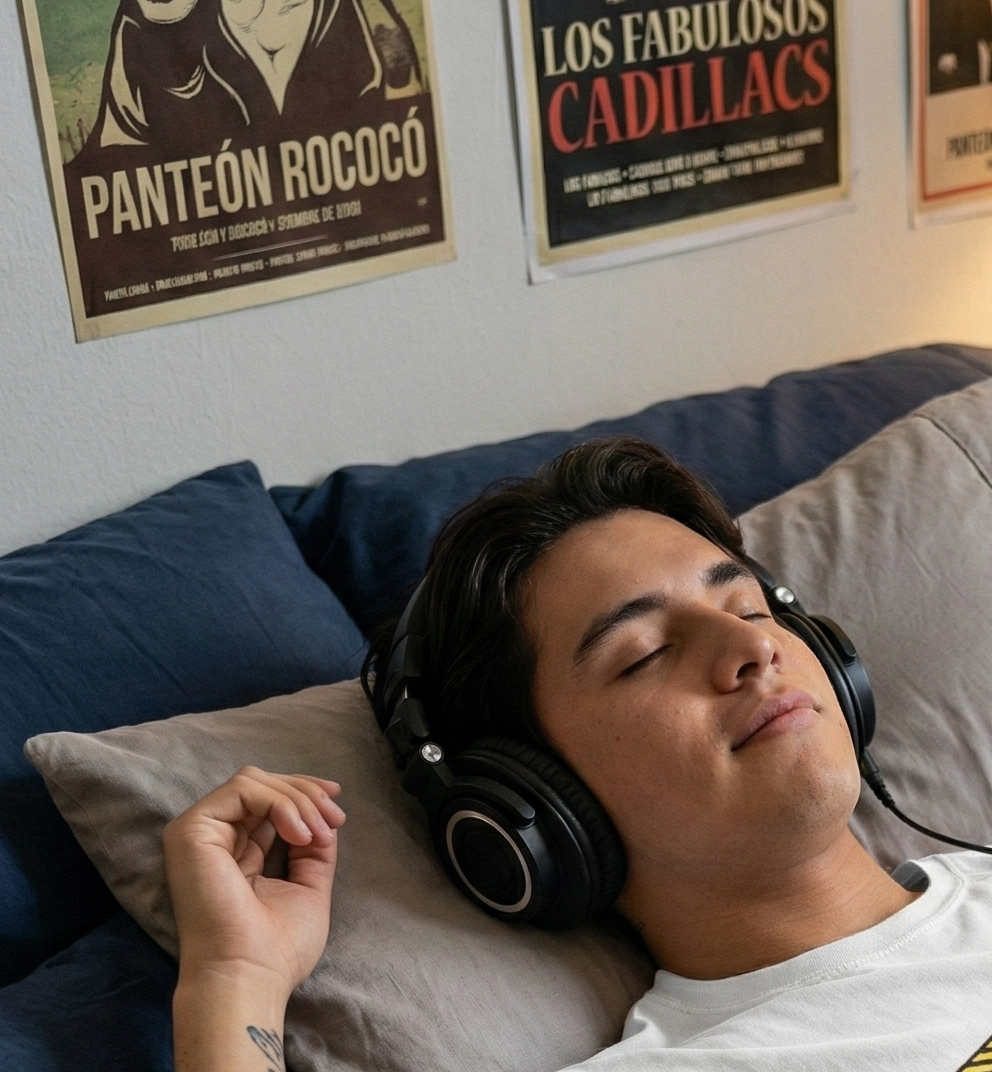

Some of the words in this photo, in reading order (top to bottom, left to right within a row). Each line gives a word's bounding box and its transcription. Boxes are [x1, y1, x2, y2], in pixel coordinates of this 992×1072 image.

[541, 17, 614, 77] LOS
[620, 0, 829, 64] FABULOSOS
[548, 38, 832, 154] CADILLACS
[81, 138, 271, 240] PANTEÓN
[279, 106, 428, 202] ROCOCÓ
